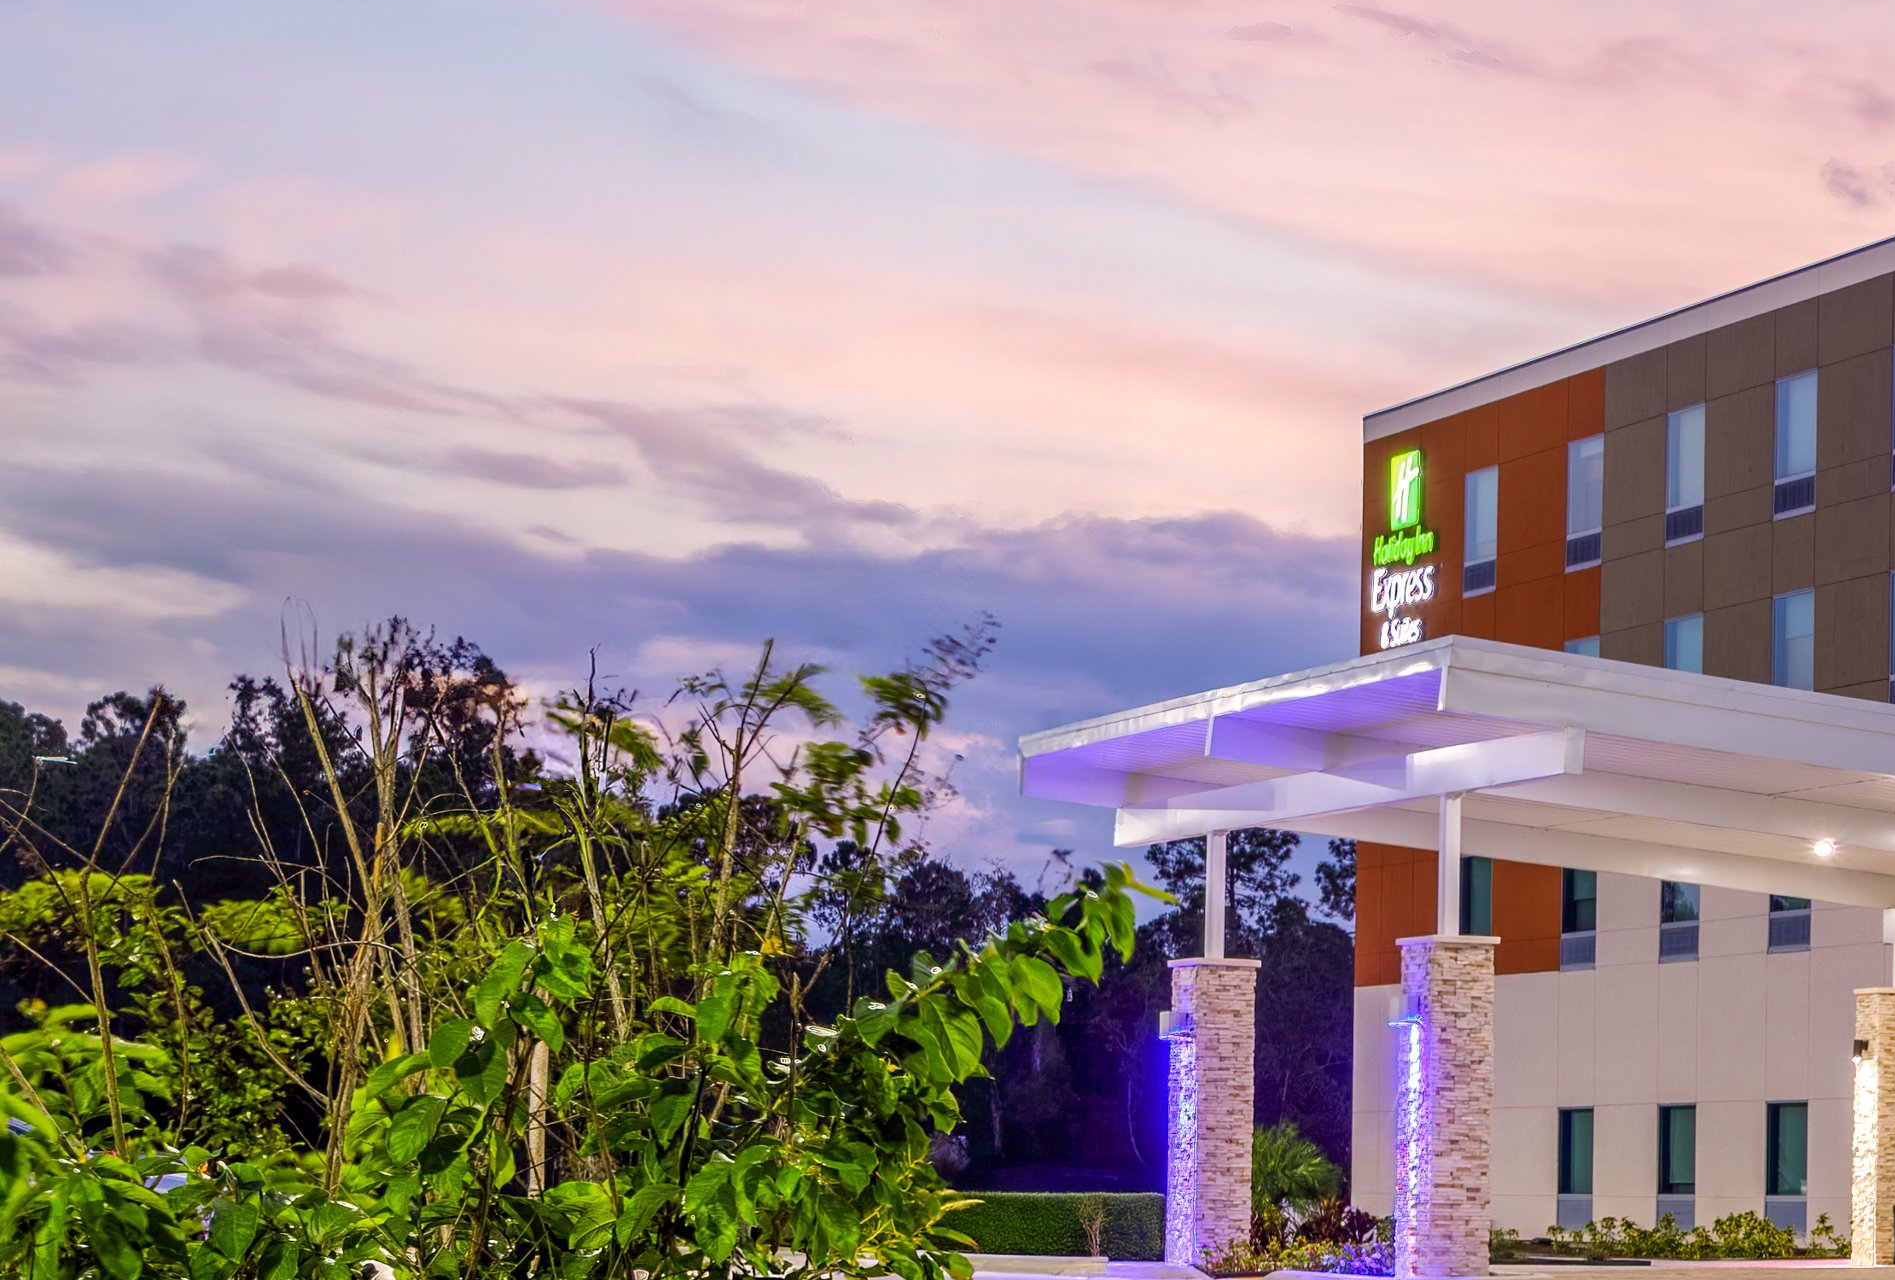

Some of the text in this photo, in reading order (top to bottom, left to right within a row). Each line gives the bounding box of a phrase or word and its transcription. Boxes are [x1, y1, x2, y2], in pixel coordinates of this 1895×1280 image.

[1373, 524, 1435, 566] Holiday Inn
[1370, 566, 1436, 619] Express
